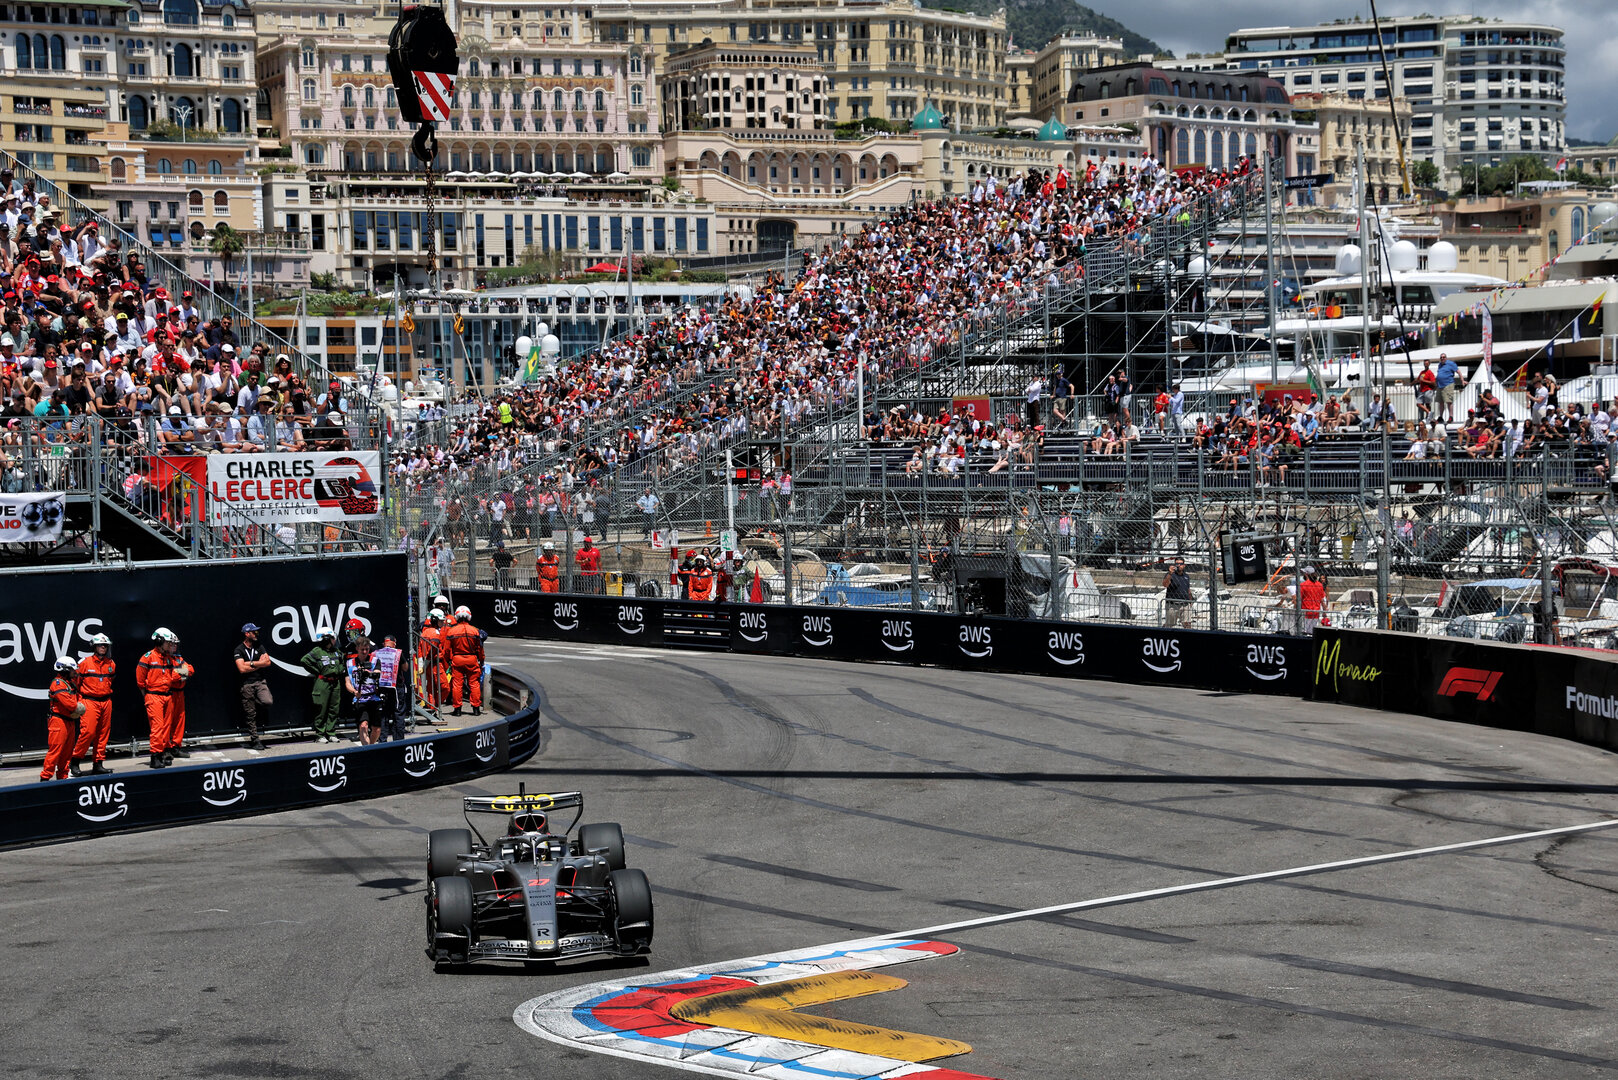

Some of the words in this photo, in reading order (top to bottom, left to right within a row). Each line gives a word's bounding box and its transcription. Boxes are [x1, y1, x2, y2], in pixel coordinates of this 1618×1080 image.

[1290, 177, 1317, 187] salesforce
[226, 459, 315, 479] CHARLES
[212, 478, 312, 503] LECLERC
[223, 509, 265, 519] MARCHE
[271, 507, 290, 517] FAN
[294, 506, 319, 516] CLUB
[235, 502, 255, 510] THE
[261, 500, 306, 510] OFFICIAL
[1240, 544, 1255, 555] aws
[494, 599, 517, 615] aws
[554, 602, 578, 618] aws
[618, 605, 643, 622] aws
[271, 601, 373, 646] aws
[740, 611, 767, 629] aws
[803, 615, 832, 633] aws
[882, 619, 913, 638] aws
[959, 624, 991, 644] aws
[1049, 630, 1083, 650] aws
[1143, 637, 1180, 658] aws
[1247, 643, 1285, 665] aws
[1315, 637, 1382, 693] Monaco
[476, 728, 496, 749] aws
[405, 742, 434, 764] aws
[309, 755, 346, 778] aws
[203, 768, 245, 792] aws
[78, 782, 126, 806] aws
[528, 878, 551, 887] 27
[537, 928, 550, 937] R
[478, 940, 527, 952] Revolut
